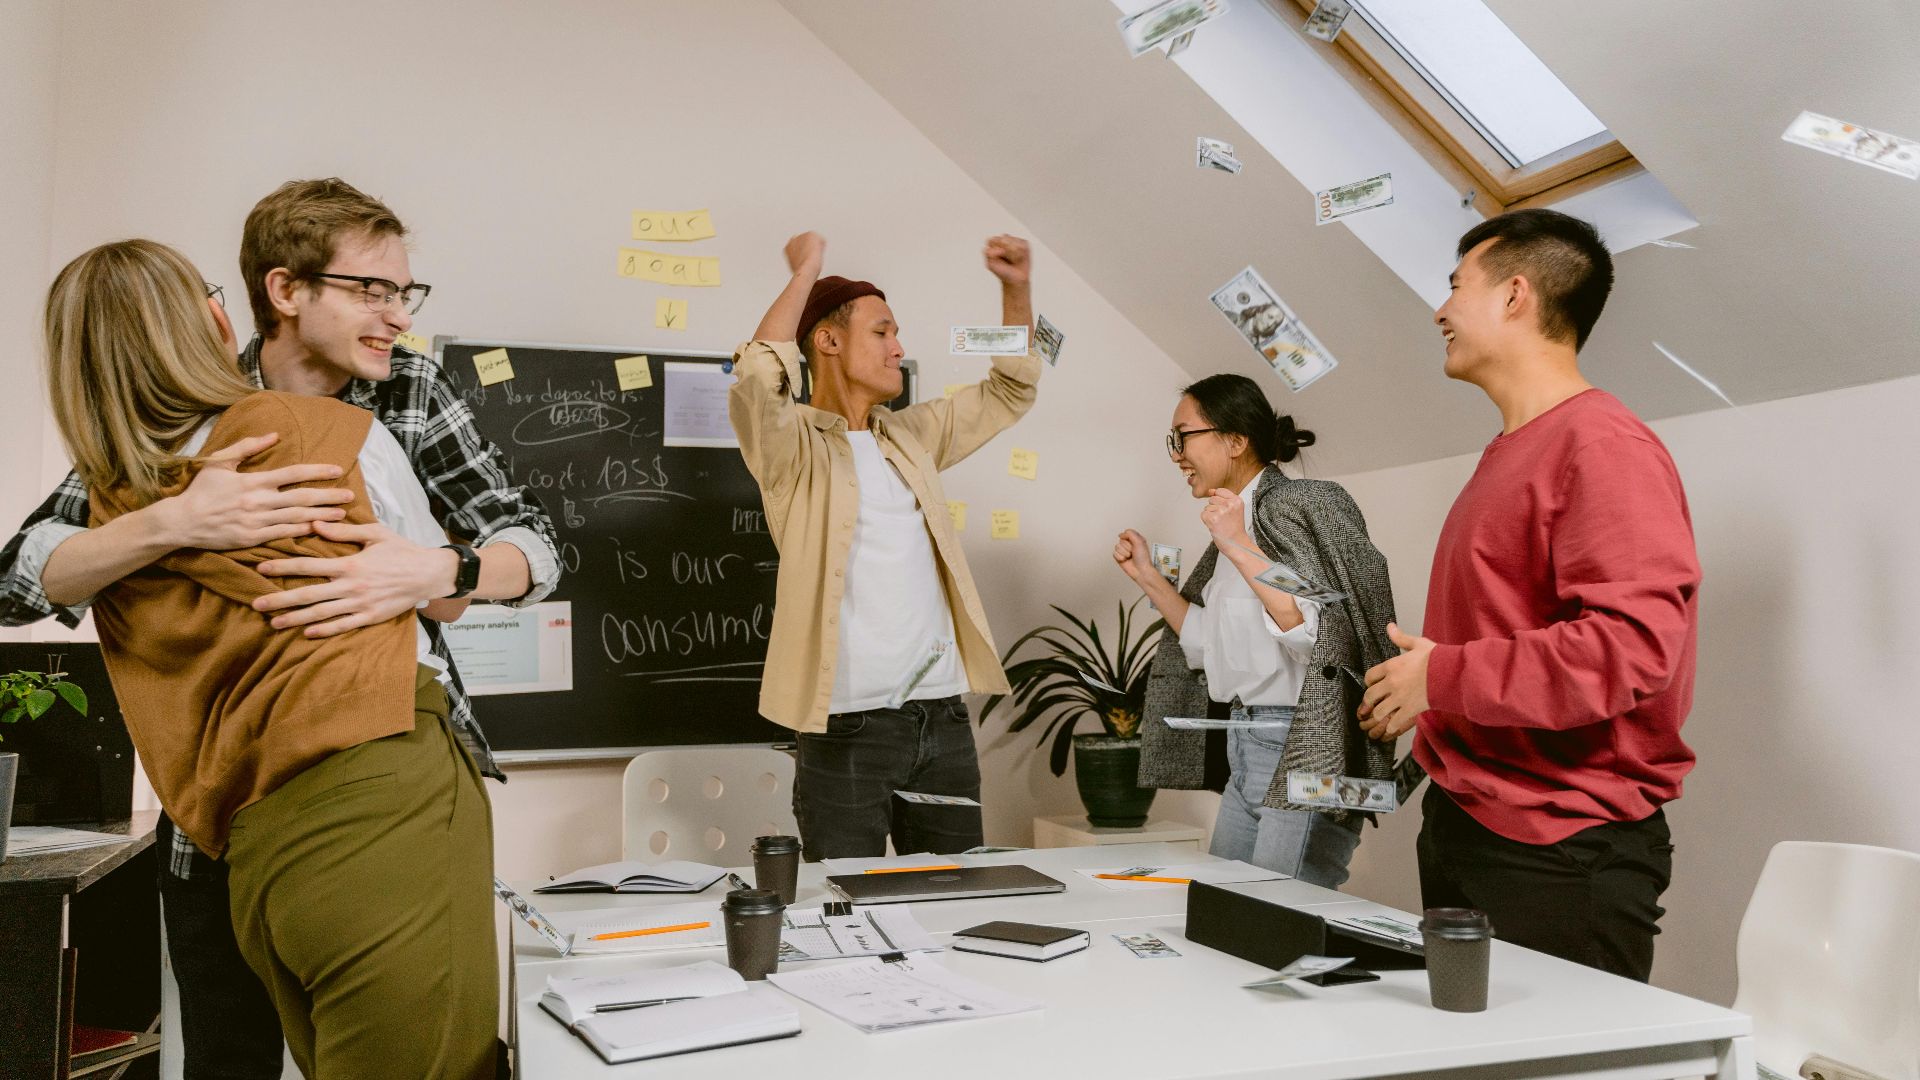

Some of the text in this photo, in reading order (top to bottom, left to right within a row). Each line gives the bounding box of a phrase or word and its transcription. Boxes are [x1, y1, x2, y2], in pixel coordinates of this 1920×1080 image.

[638, 216, 700, 236] our
[623, 256, 712, 282] goal
[608, 537, 648, 584] is
[672, 551, 745, 584] our
[447, 620, 521, 632] Company analysis
